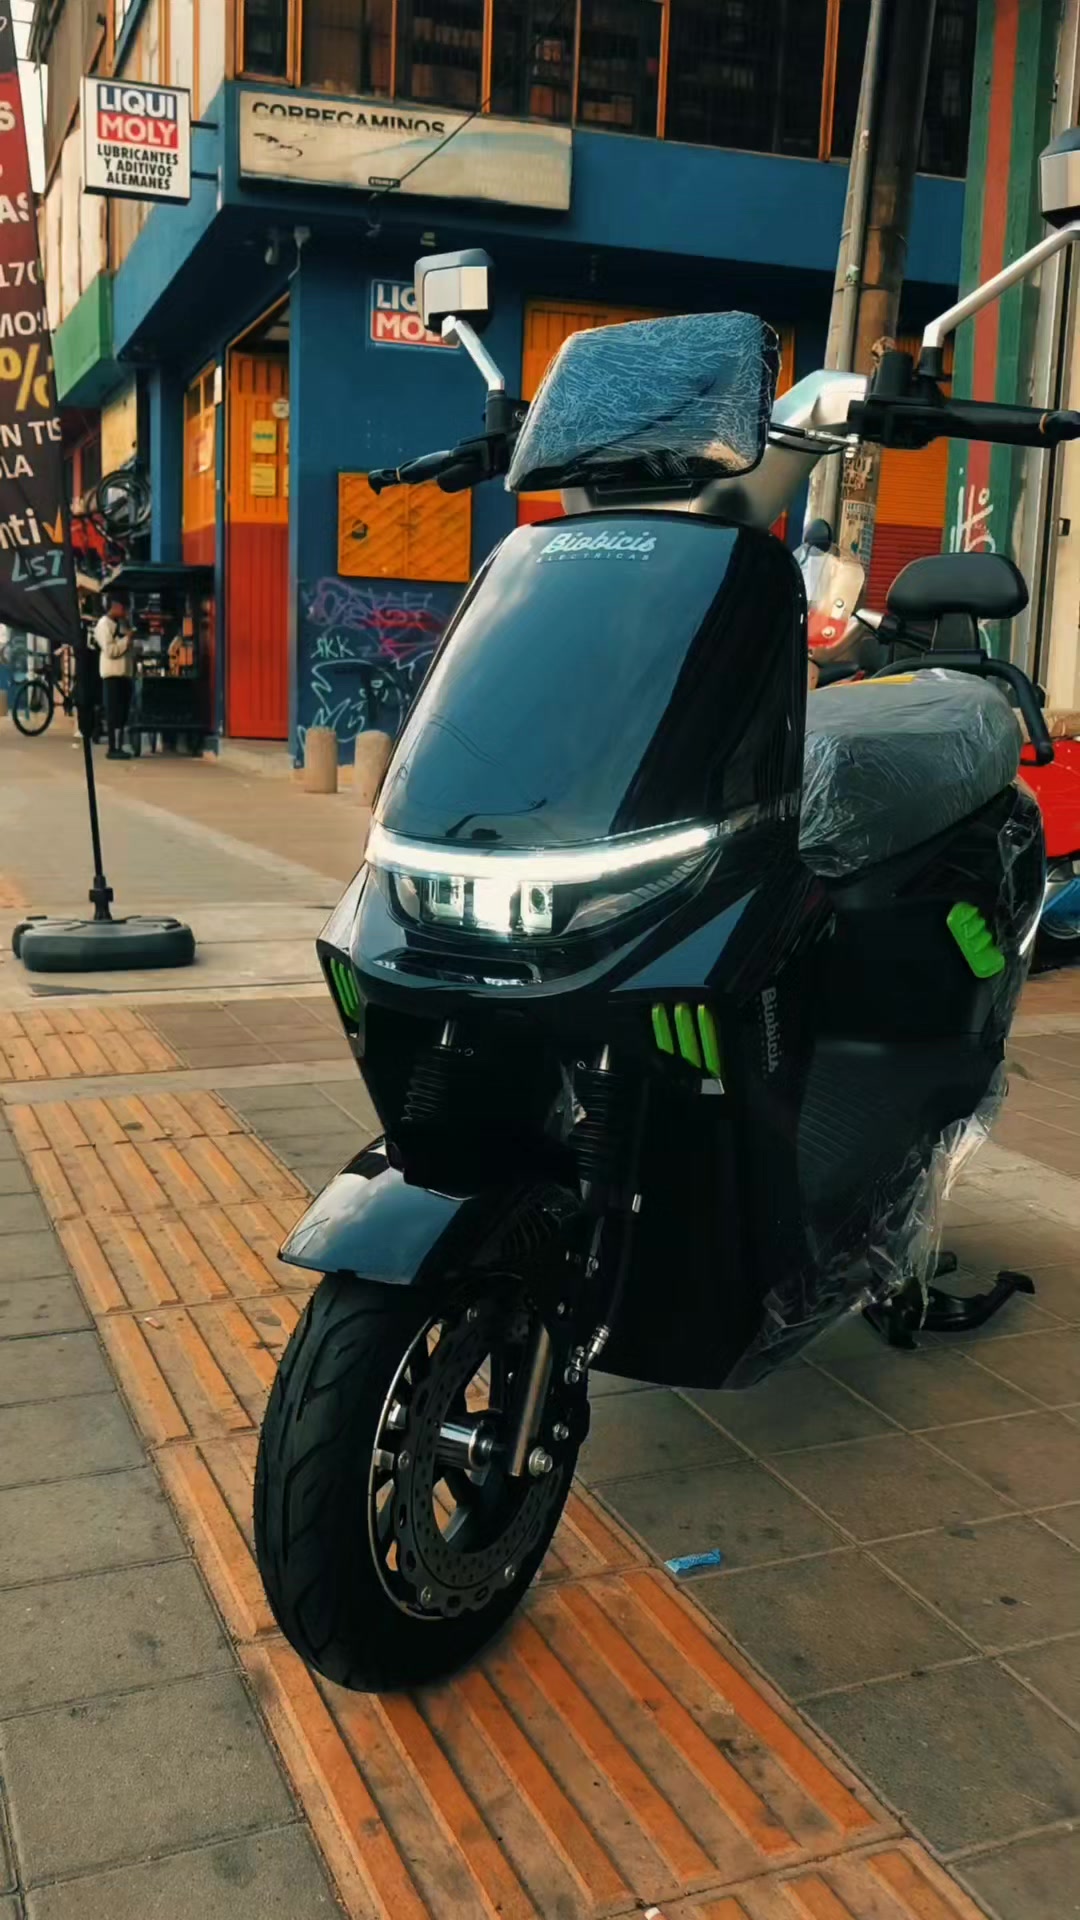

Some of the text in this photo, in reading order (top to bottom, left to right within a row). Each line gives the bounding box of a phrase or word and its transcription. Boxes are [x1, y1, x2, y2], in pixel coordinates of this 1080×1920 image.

[100, 86, 175, 119] LIQUI
[101, 114, 176, 146] MOLY
[97, 143, 179, 166] LUBRICANTES
[105, 158, 173, 178] Y ADITIVOS
[106, 171, 170, 191] ALEMANES
[376, 284, 419, 312] LIQ
[376, 312, 442, 342] MOL
